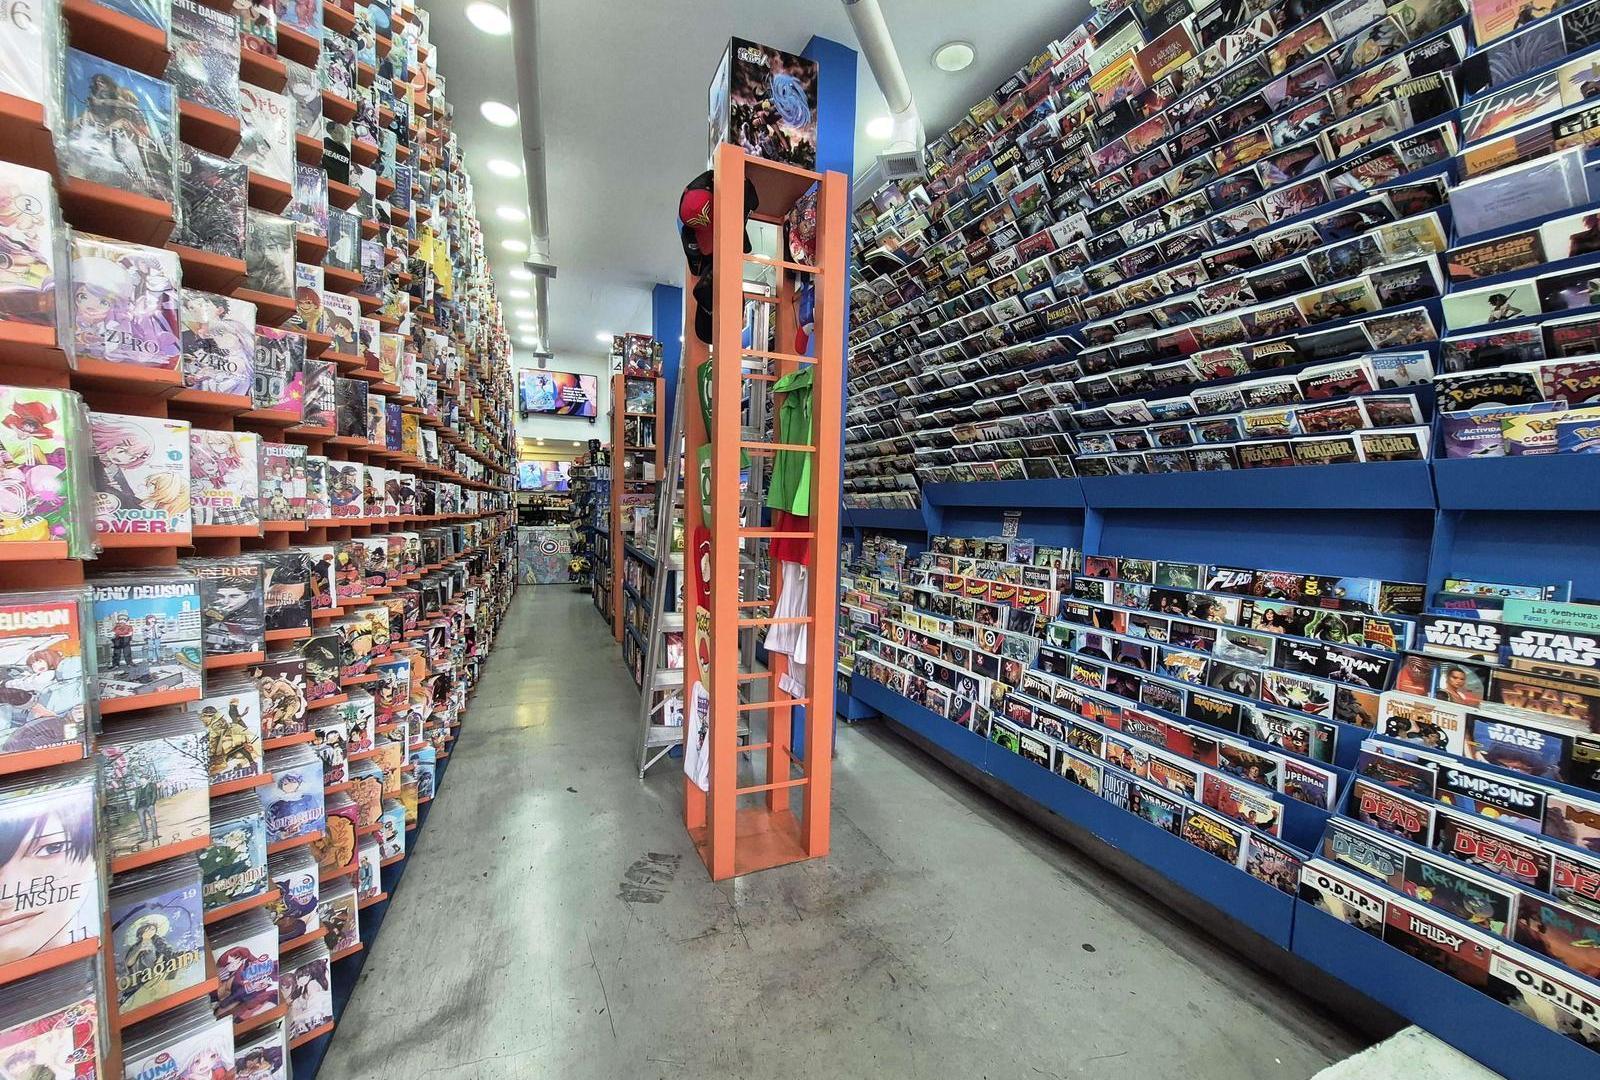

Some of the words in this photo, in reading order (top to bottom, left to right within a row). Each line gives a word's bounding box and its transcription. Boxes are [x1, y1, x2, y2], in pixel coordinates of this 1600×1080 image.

[1069, 74, 1090, 93] THOR
[1394, 76, 1442, 98] WOLVERINE
[1461, 79, 1559, 137] Huck
[1061, 131, 1085, 149] MARVELS
[1407, 144, 1430, 157] CIVIL
[1418, 148, 1437, 159] WAR
[1341, 154, 1371, 171] X-MEN
[1357, 158, 1383, 173] CIVIL
[1496, 236, 1536, 252] COMO
[1461, 256, 1478, 266] LA
[1479, 245, 1533, 262] MUERTE
[1047, 305, 1072, 324] AVENGERS
[1255, 307, 1296, 324] AVENGERS
[1253, 341, 1296, 360] AVENGERS
[1310, 373, 1359, 388] MIGNOLA
[1250, 388, 1293, 399] MOORE
[266, 446, 304, 459] DELUSION
[1242, 446, 1290, 464] PREACHER
[1296, 442, 1352, 461] PREACHER
[263, 457, 270, 466] 2
[203, 490, 232, 498] YOUR
[117, 508, 168, 521] YOUR
[1207, 570, 1253, 590] FLASH
[133, 583, 195, 598] DELUSION
[1532, 606, 1547, 615] Las
[1550, 608, 1599, 620] Aventuras
[1425, 620, 1500, 639] STAR
[1425, 631, 1500, 651] WARS
[1509, 630, 1600, 653] STAR
[1293, 650, 1318, 666] BAT
[1326, 651, 1381, 674] BATMAN
[1510, 642, 1600, 666] WARS
[1074, 665, 1104, 680] BATMAN
[1194, 697, 1233, 714] BATMAN
[1488, 724, 1545, 742] STAR
[1489, 731, 1545, 750] WARS
[1468, 790, 1509, 807] COMICS
[1361, 794, 1421, 833] DEAD
[1188, 815, 1238, 848] CRISIS
[1332, 836, 1395, 876] DEAD
[1455, 831, 1540, 878] DEAD
[15, 882, 81, 912] INSIDE
[181, 888, 197, 901] 19
[1317, 876, 1372, 911] O.D.I.P.
[68, 925, 88, 944] 11
[1409, 916, 1464, 951] HELLBOY
[1514, 968, 1599, 1022] O.D.I.P.
